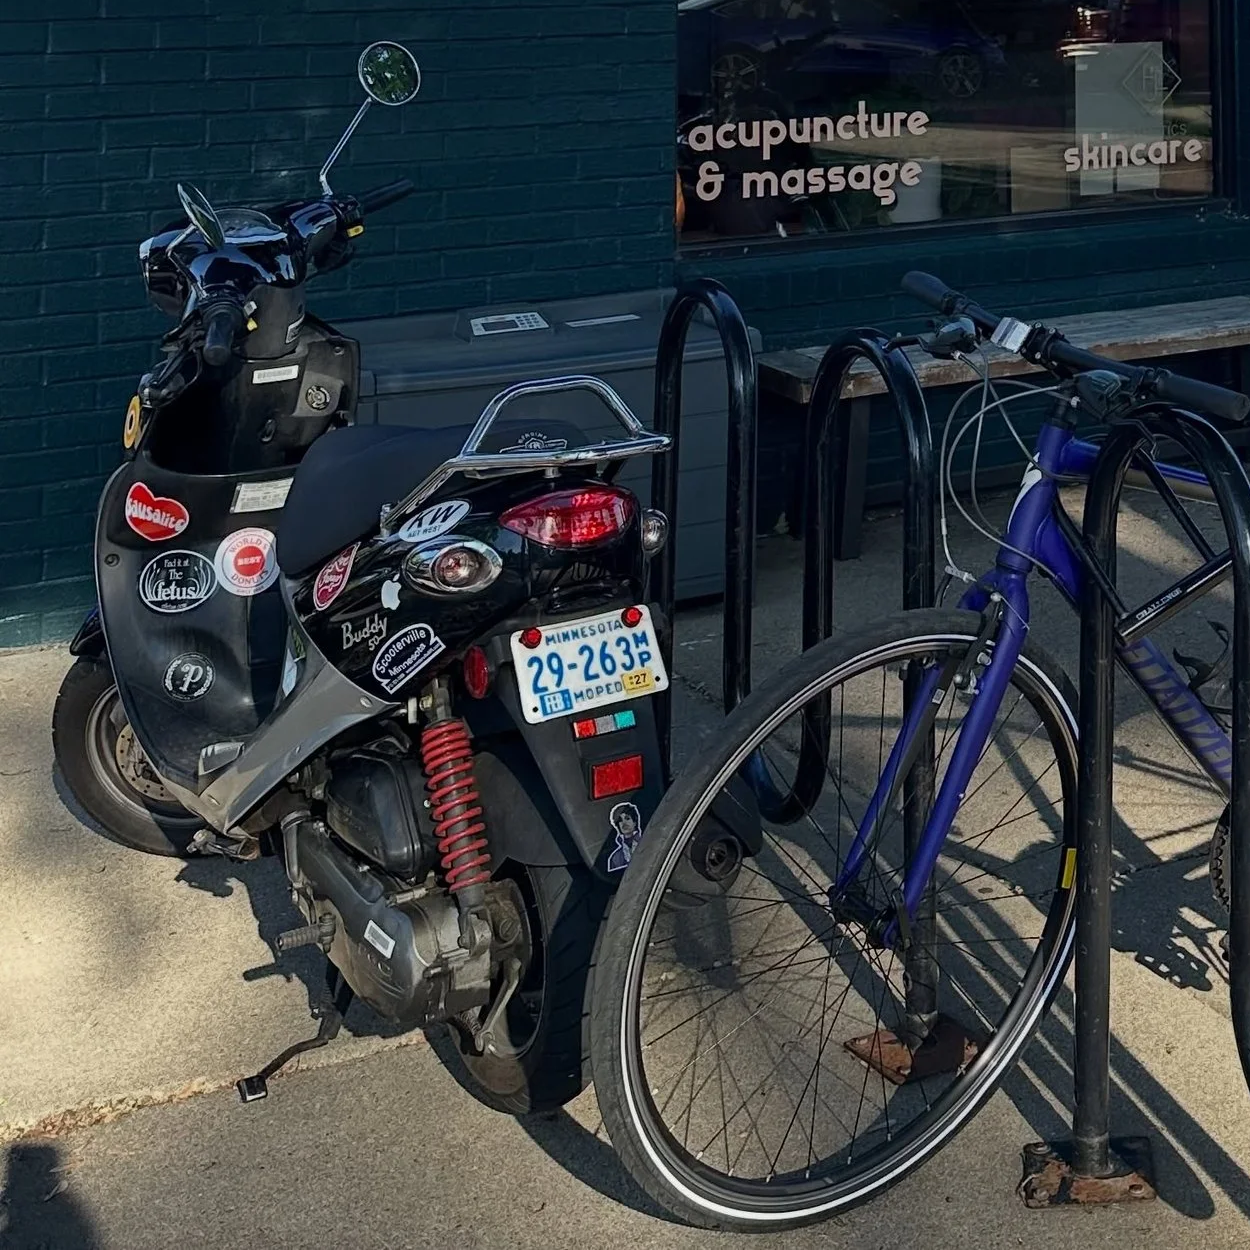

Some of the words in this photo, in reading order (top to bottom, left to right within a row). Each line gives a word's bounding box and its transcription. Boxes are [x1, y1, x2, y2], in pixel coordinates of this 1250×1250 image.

[688, 100, 930, 160] acupuncture
[1064, 131, 1204, 172] skincare
[695, 161, 723, 201] &
[742, 159, 923, 205] massage
[125, 497, 187, 532] Sausalito
[407, 503, 464, 532] KW
[422, 524, 442, 535] WEST
[168, 568, 184, 580] The
[237, 555, 262, 566] BEST
[156, 581, 196, 601] fetus
[341, 613, 388, 650] Buddy
[545, 619, 624, 646] MINNESOTA
[376, 629, 426, 674] Scooterville
[388, 642, 426, 676] Minnesota
[526, 636, 635, 695] 29-263
[574, 681, 623, 703] MOPED
[633, 673, 647, 686] 27
